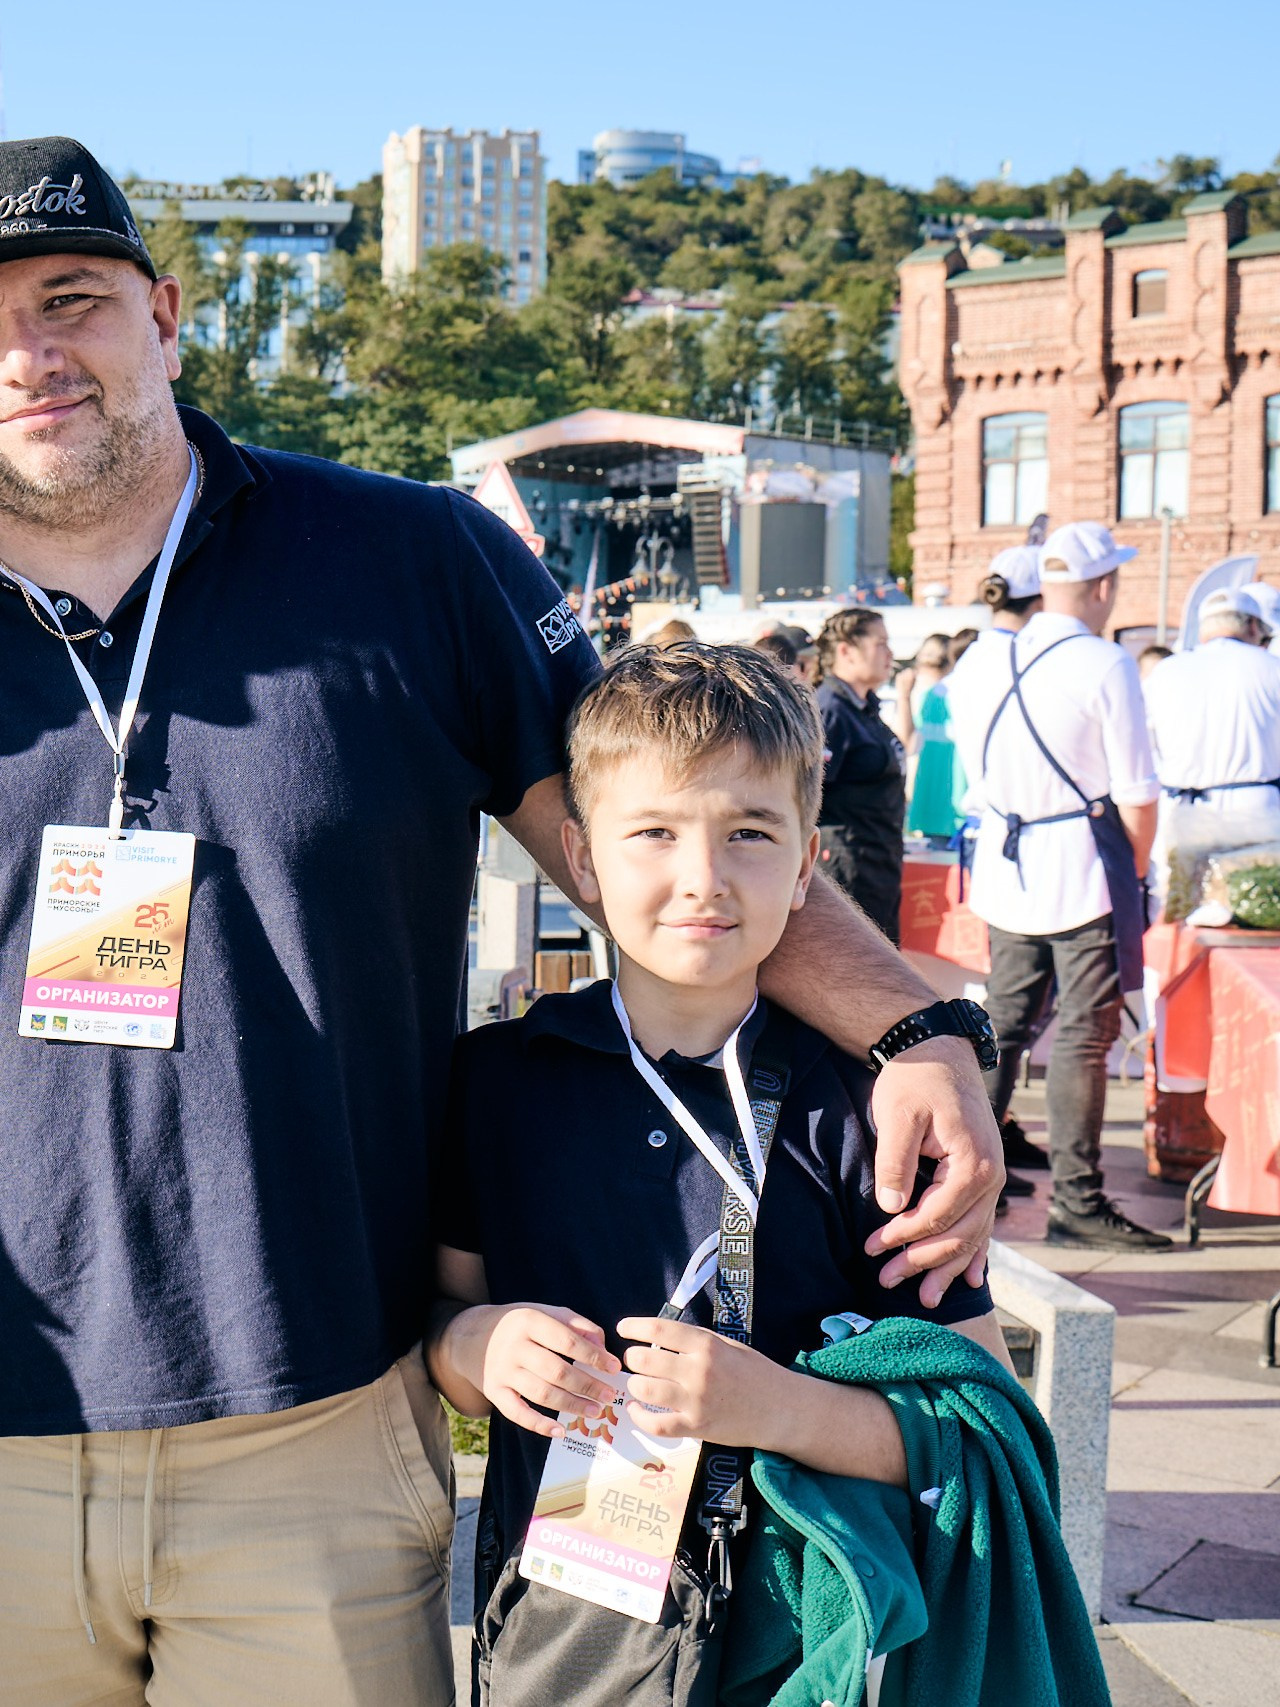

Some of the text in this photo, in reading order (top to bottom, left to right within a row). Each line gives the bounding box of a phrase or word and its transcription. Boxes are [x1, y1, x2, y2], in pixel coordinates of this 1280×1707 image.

[127, 182, 277, 202] ATINUM PLAZA
[52, 848, 105, 859] ПРИМОРЬЯ
[131, 854, 177, 864] PRIMORYE
[132, 846, 156, 855] VISIT
[47, 898, 100, 908] ПРИМОРСКИЕ
[134, 902, 170, 929] 25
[97, 936, 171, 955] ДЕНЬ
[95, 953, 168, 971] ТИГРА
[36, 985, 170, 1010] ОРГАНИЗАТОР
[563, 1436, 611, 1457] ПРИМОРСКИЕ
[600, 1488, 671, 1524] ДЕНЬ
[598, 1505, 665, 1540] ТИГРА
[539, 1528, 661, 1581] ОРГАНИЗАТОР
